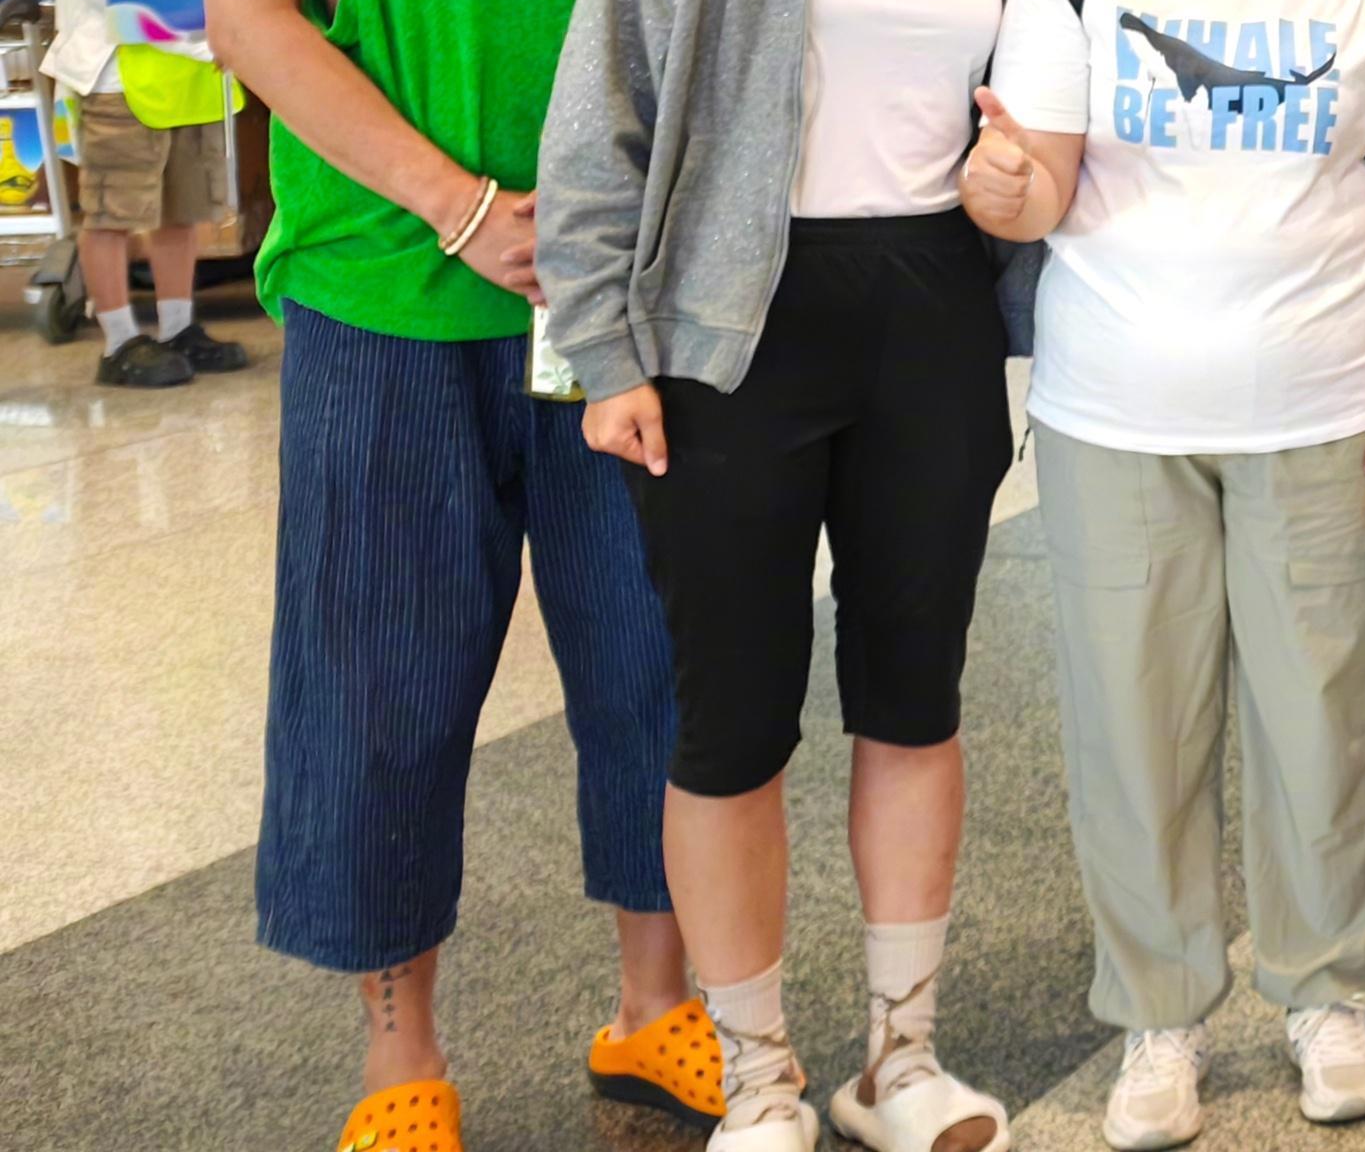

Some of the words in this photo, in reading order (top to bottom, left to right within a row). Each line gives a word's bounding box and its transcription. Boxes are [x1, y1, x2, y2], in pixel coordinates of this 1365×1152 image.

[1115, 6, 1341, 83] WHALE
[1113, 84, 1179, 148] BE
[1209, 83, 1339, 156] FREE
